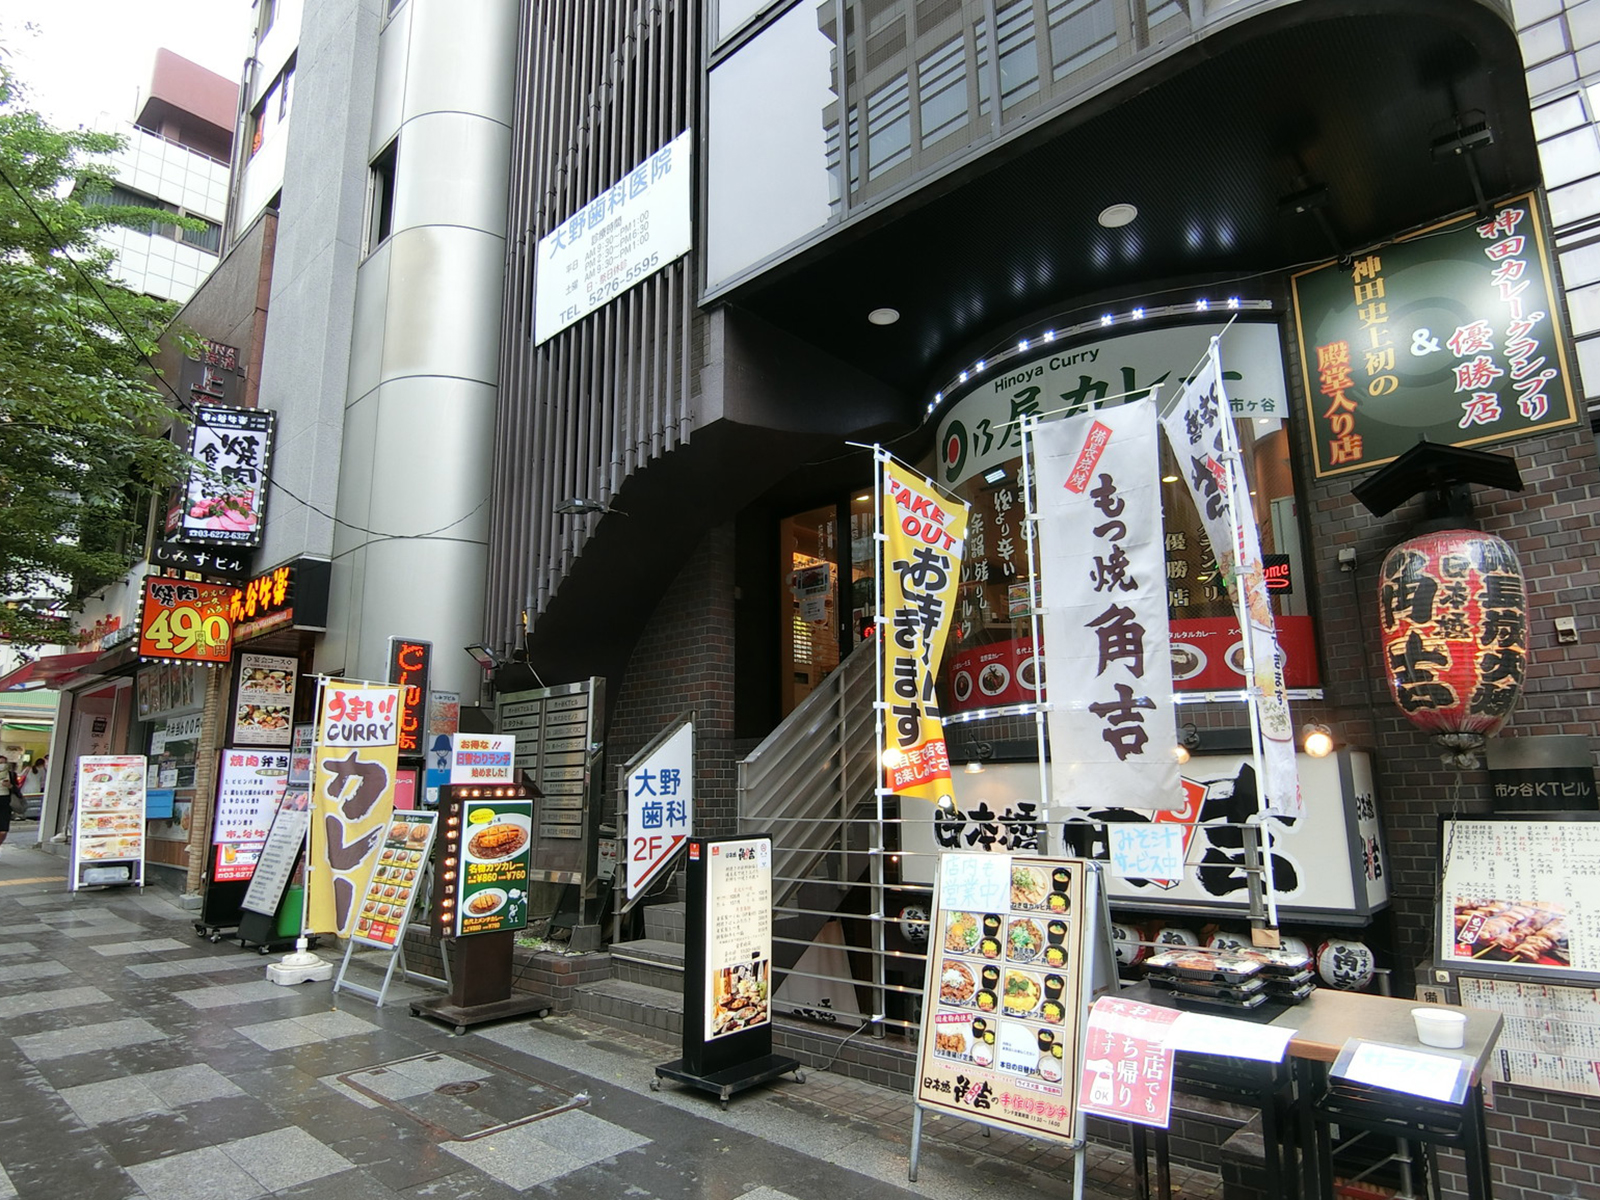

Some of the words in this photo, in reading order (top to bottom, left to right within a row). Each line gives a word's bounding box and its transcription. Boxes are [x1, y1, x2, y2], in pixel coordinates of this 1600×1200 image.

[549, 147, 672, 260] 大野歯科医院
[559, 303, 581, 325] TEL
[589, 251, 659, 306] 5276-5595
[1351, 255, 1399, 397] 神田史上初の
[1476, 208, 1557, 421] 神田カレーグランプリ
[1410, 328, 1441, 356] &
[994, 364, 1044, 393] Hinoya
[1049, 348, 1100, 371] Curry
[1447, 320, 1503, 429] 優勝店
[1316, 340, 1364, 466] 殿堂入り店
[221, 433, 259, 485] 焼肉
[1068, 427, 1108, 491] 備長炭焼
[888, 474, 946, 526] TAKE
[198, 529, 251, 541] 03-6272-6327
[901, 515, 957, 551] OUT
[157, 547, 243, 571] しみずビル
[1165, 531, 1190, 608] 優勝店
[151, 583, 198, 607] 焼肉
[145, 606, 230, 655] 490
[327, 690, 397, 722] うまい!
[326, 721, 394, 742] CURRY
[460, 740, 490, 749] お得な
[229, 755, 288, 768] 焼肉弁当
[456, 752, 511, 765] 日替わりランチ
[471, 768, 508, 778] 始めました!
[634, 768, 681, 797] 大野
[1495, 781, 1591, 798] 市ヶ谷KTビル
[641, 799, 688, 829] 歯科
[322, 750, 387, 934] カレー
[633, 835, 663, 862] 2F
[1113, 825, 1178, 851] みそ汁
[468, 861, 525, 874] 名物カツカレー
[476, 872, 497, 883] ¥860
[505, 870, 526, 881] ¥760
[945, 855, 996, 877] 店内も
[1113, 852, 1178, 875] サービス中
[1000, 1061, 1041, 1076] 本日の日替わり
[1000, 1091, 1069, 1121] 手作りランチ
[1094, 1089, 1109, 1101] OK
